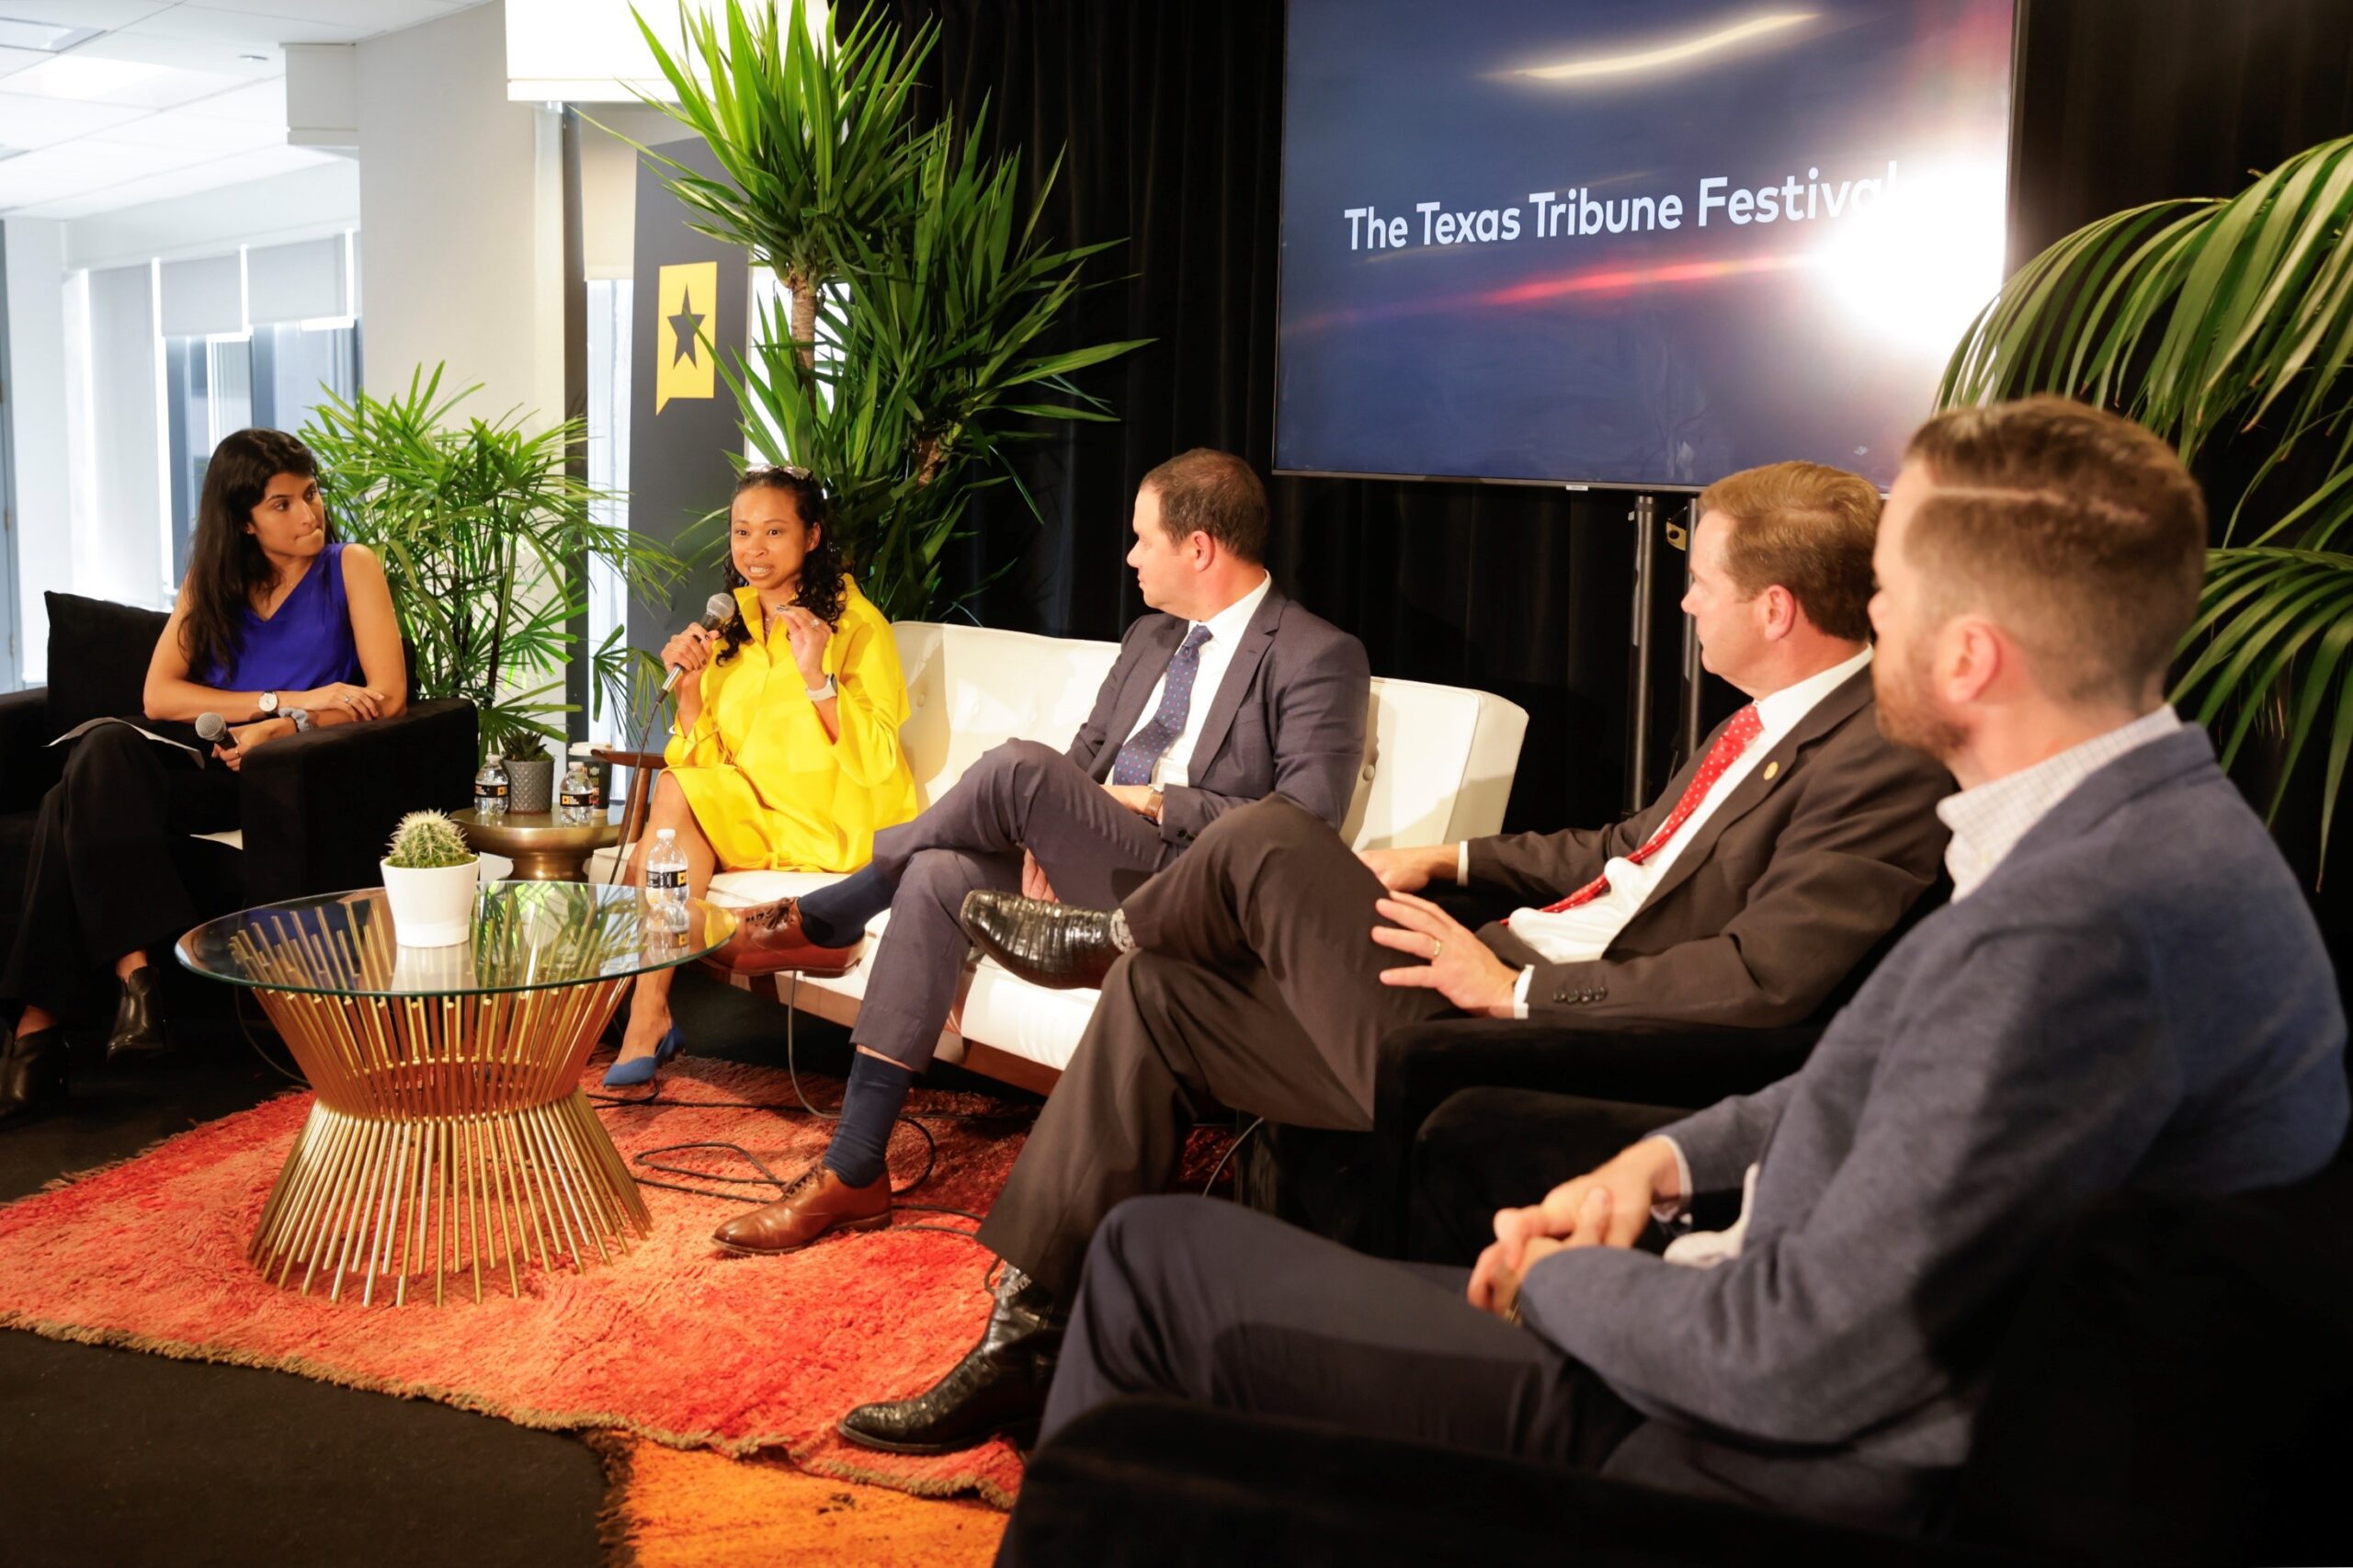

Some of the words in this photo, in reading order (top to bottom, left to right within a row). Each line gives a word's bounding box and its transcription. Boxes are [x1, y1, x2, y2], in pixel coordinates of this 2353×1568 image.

[1345, 207, 1408, 250] The
[1416, 201, 1521, 245] Texas
[1529, 187, 1683, 237] Tribune
